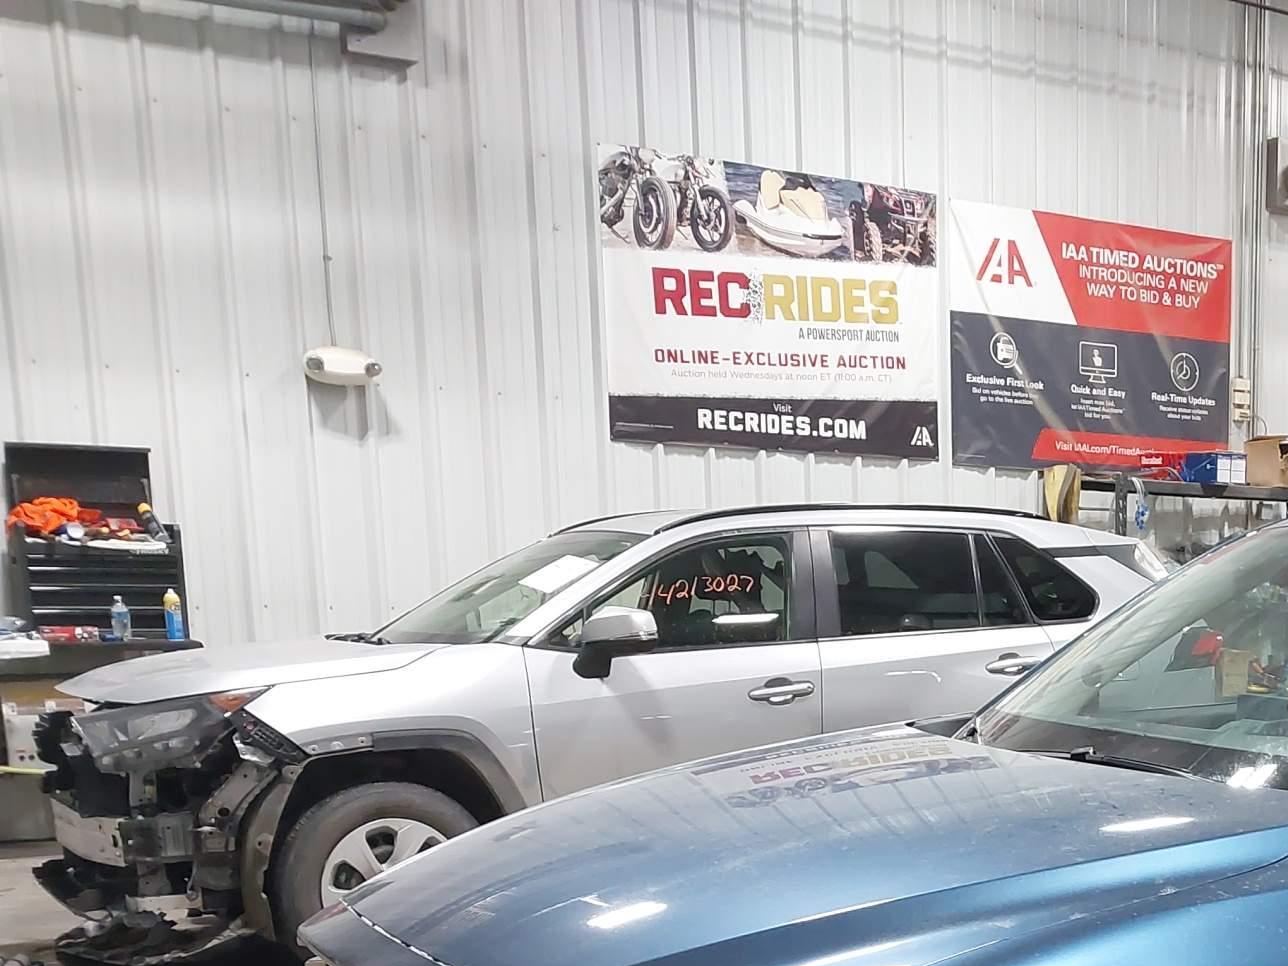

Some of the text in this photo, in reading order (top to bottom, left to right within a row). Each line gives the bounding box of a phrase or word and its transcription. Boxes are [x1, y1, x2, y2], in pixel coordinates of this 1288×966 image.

[1062, 242, 1088, 262] IAA
[1089, 247, 1140, 268] TIMED
[1079, 265, 1208, 294] INTRODUCING A NEW
[762, 273, 901, 325] RIDES
[1087, 282, 1201, 309] WAY TO BID & BUY
[798, 327, 900, 342] A POWERSPORT AUCTION
[654, 348, 907, 370] ONLINE-EXCLUSIVE AUCTION
[671, 369, 706, 379] Auction
[708, 369, 728, 379] held
[730, 370, 783, 381] Wednesdays
[786, 372, 795, 380] at
[796, 373, 817, 382] noon
[965, 373, 1006, 386] Exclusive
[1006, 376, 1025, 388] First
[1070, 384, 1126, 399] Quick and Easy
[1151, 392, 1216, 406] Real-Time Updates
[773, 402, 792, 413] Visit
[697, 408, 867, 440] RECRIDES.COM
[1055, 440, 1073, 451] Visit
